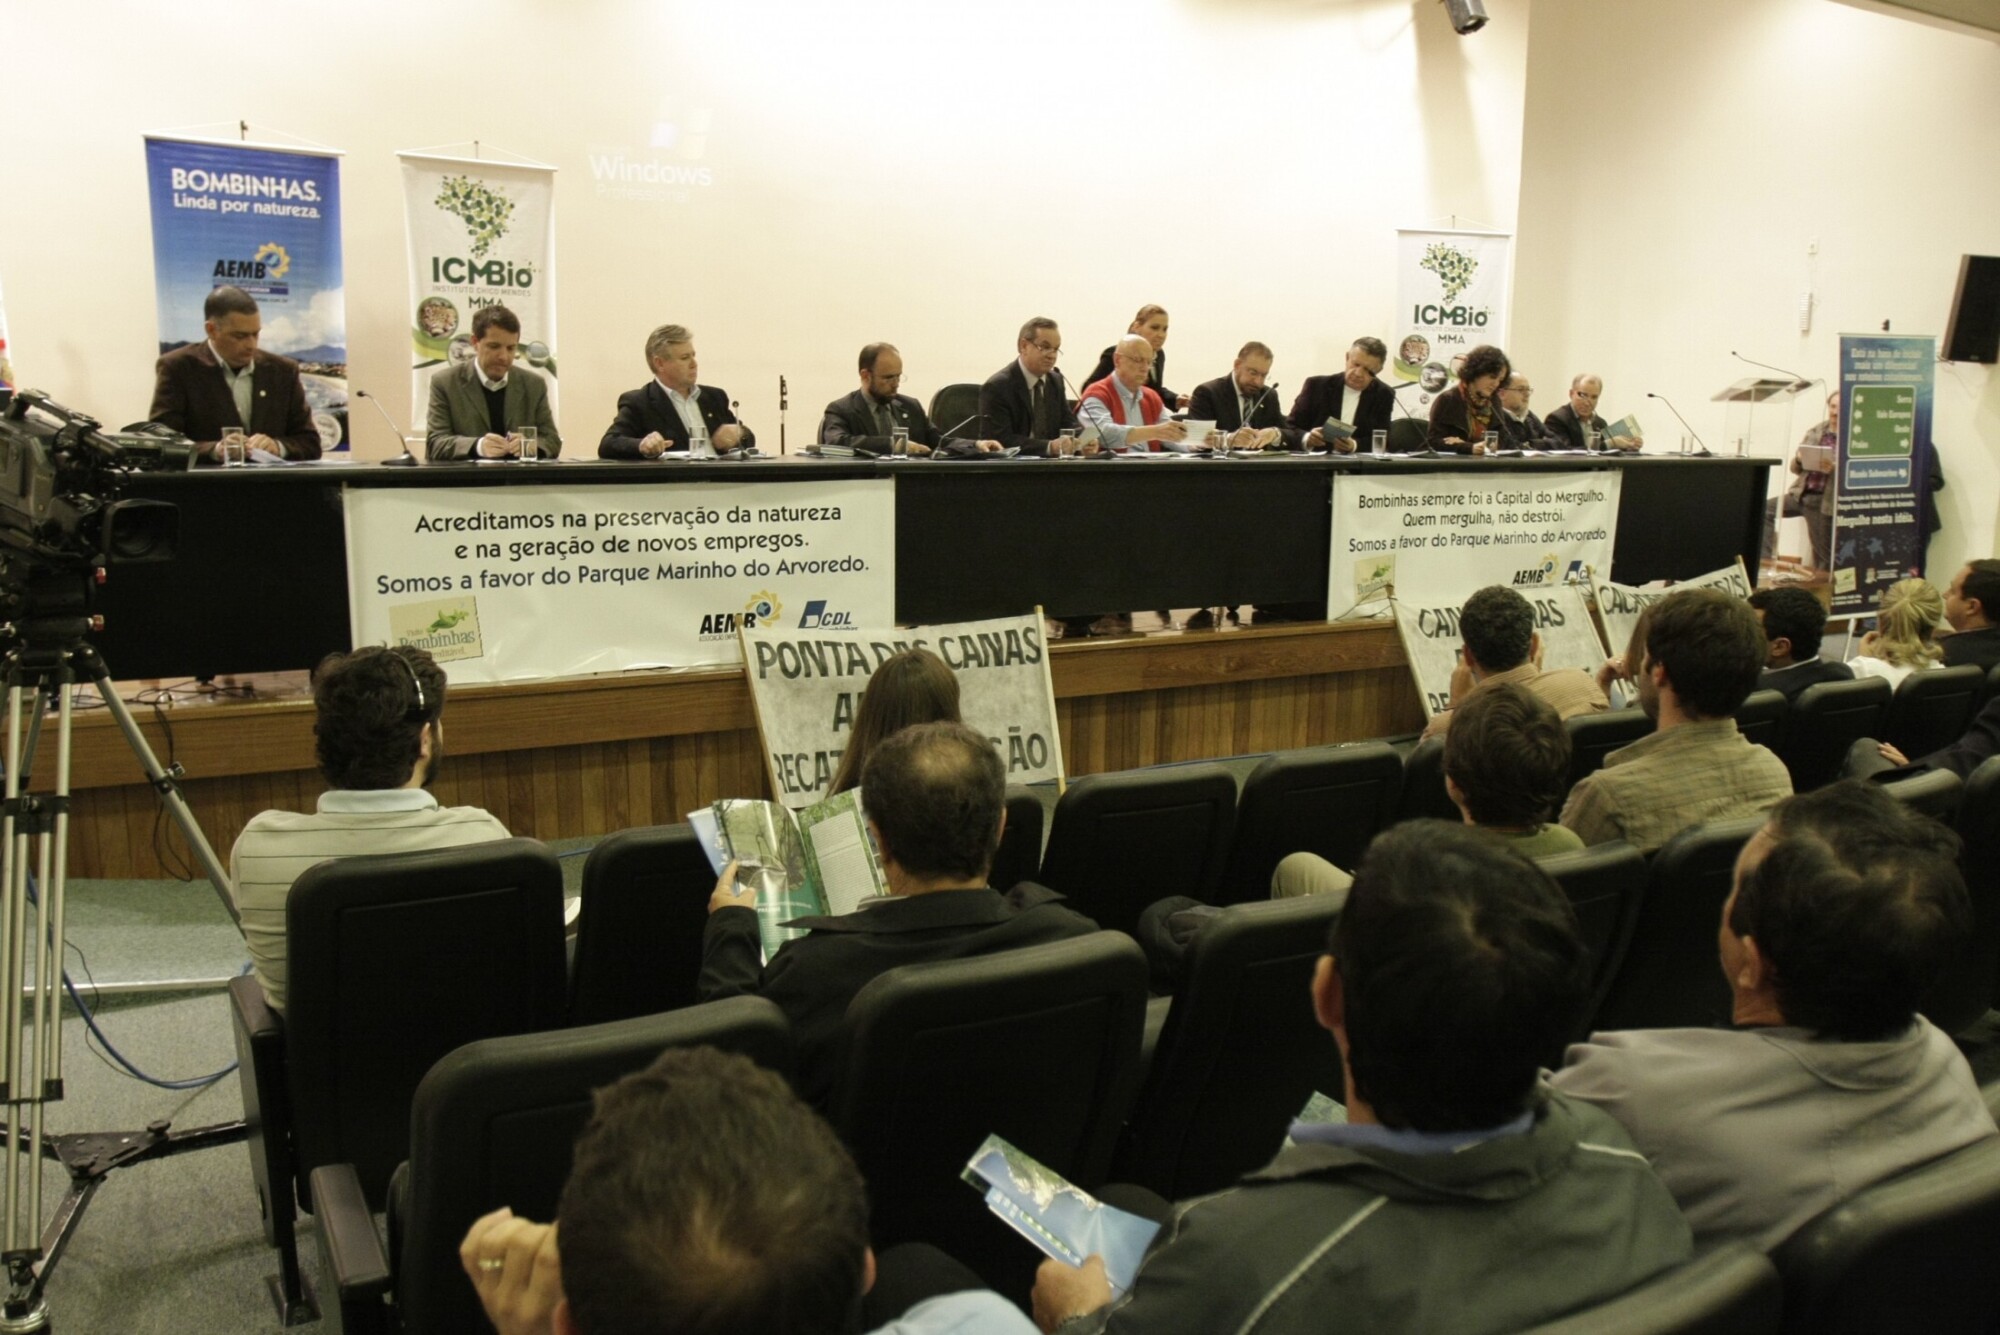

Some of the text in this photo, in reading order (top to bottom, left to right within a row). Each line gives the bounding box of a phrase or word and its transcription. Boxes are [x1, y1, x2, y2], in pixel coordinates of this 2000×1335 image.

[588, 154, 713, 187] Windows
[171, 168, 321, 202] BOMBINHAS.
[173, 193, 320, 218] Linda por natureza.
[213, 259, 266, 279] AEMB
[432, 257, 533, 288] ICMBio
[432, 285, 531, 297] INSTITUTO CHICO MENDES
[469, 296, 504, 309] MMA
[1413, 304, 1488, 327] ICMBio
[1437, 334, 1466, 344] MMA
[1358, 489, 1607, 509] Bombinhas sempre foi a Capital do Mergulho.
[415, 506, 841, 533] Acreditamos na preservação da natureza
[1402, 508, 1566, 528] Quem mergulha, não destrói.
[454, 533, 810, 561] e na geração de novos empregos.
[1349, 528, 1606, 552] Somos a favor do Parque Marinho do Arvoredo
[377, 555, 869, 594] Somos a favor do Parque Marinho do Arvoredo.
[1512, 569, 1544, 585] AEMB
[821, 611, 852, 627] CDL
[754, 640, 872, 679] PONTA
[938, 626, 1042, 671] CANAS
